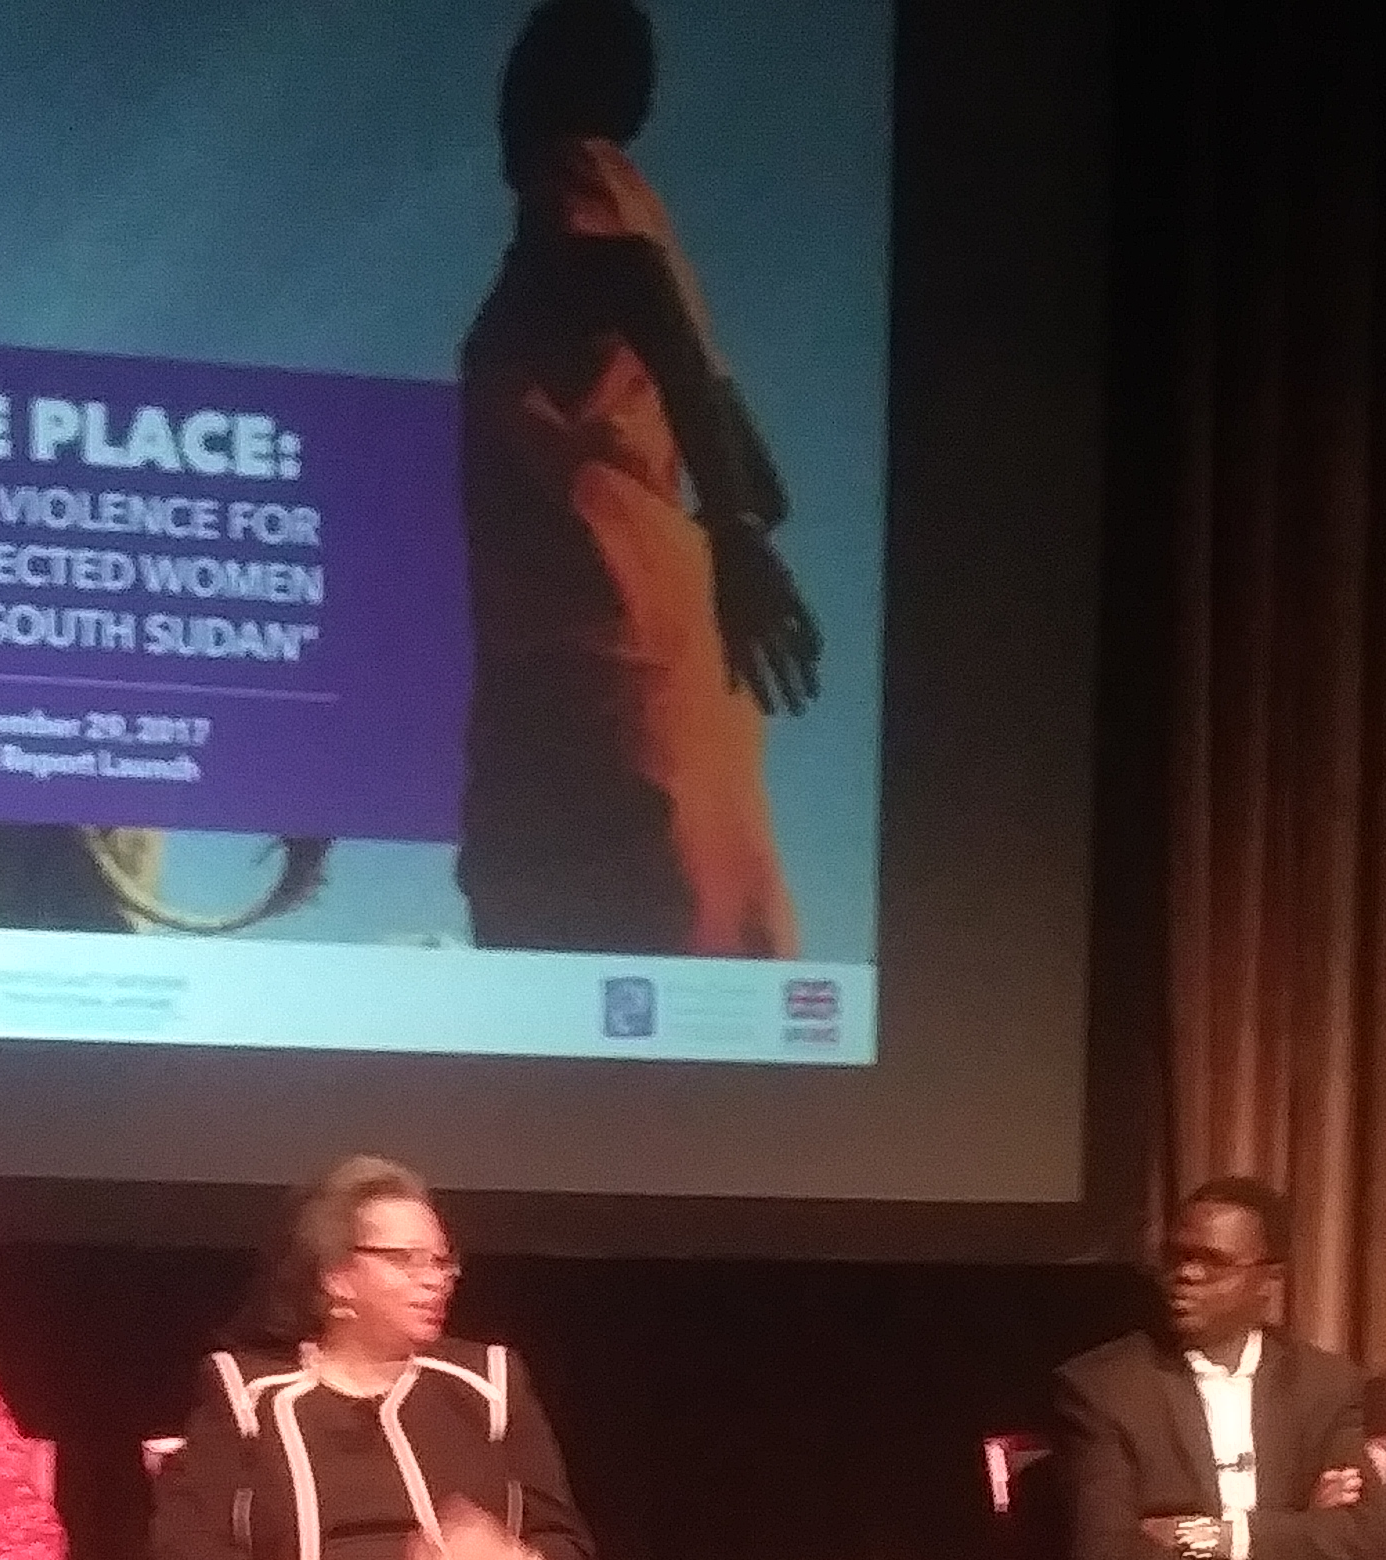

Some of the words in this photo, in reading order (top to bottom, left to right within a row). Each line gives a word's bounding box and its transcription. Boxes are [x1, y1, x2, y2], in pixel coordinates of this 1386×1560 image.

[30, 398, 303, 480] PLACE:
[227, 502, 321, 547] FOR
[137, 553, 324, 605] WOMEN
[135, 715, 211, 745] 2017
[0, 744, 98, 780] Report
[98, 750, 201, 782] Launch
